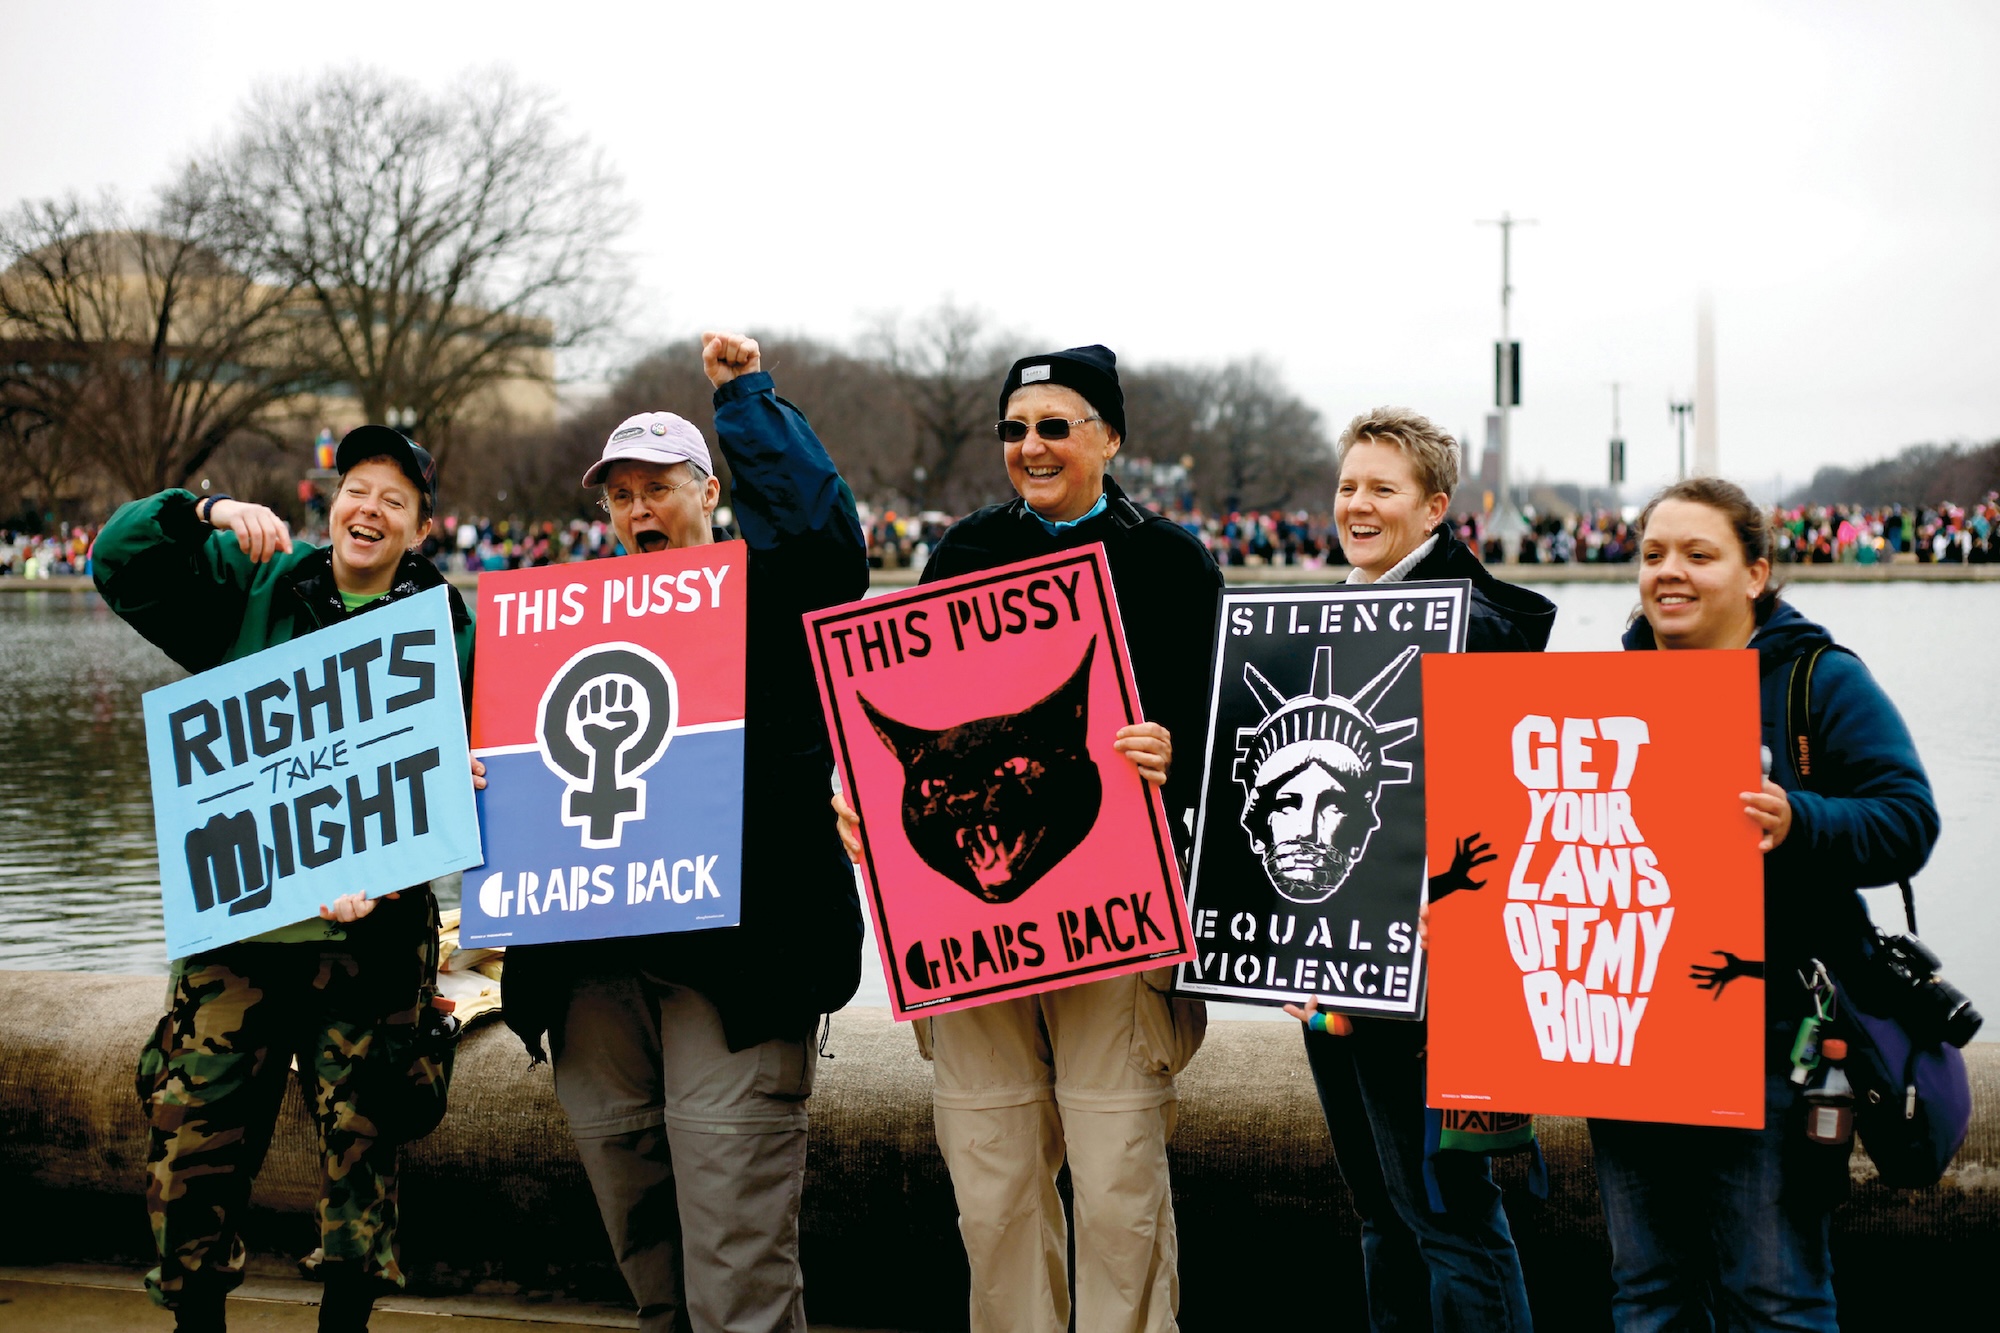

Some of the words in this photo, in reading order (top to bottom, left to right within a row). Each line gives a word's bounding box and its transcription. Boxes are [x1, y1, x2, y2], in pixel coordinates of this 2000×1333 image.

[493, 582, 588, 637] THIS
[602, 565, 731, 624] PUSSY
[831, 608, 931, 679] THIS
[948, 570, 1082, 652] PUSSY
[1231, 599, 1450, 638] SILENCE
[169, 629, 436, 787] RIGHTS
[259, 739, 349, 794] TAKE
[1511, 714, 1651, 790] GET
[185, 746, 440, 917] MIGHT
[1524, 789, 1645, 847] YOUR
[479, 864, 616, 919] GRABS
[626, 854, 722, 906] BACK
[1507, 844, 1671, 910] LAWS
[905, 920, 1046, 990] GRABS
[1057, 891, 1166, 962] BACK
[1195, 908, 1412, 955] EQUALS
[1502, 901, 1601, 973] OFF
[1584, 906, 1676, 994] MY
[1193, 951, 1410, 998] VIOLENCE
[1522, 970, 1649, 1067] BODY
